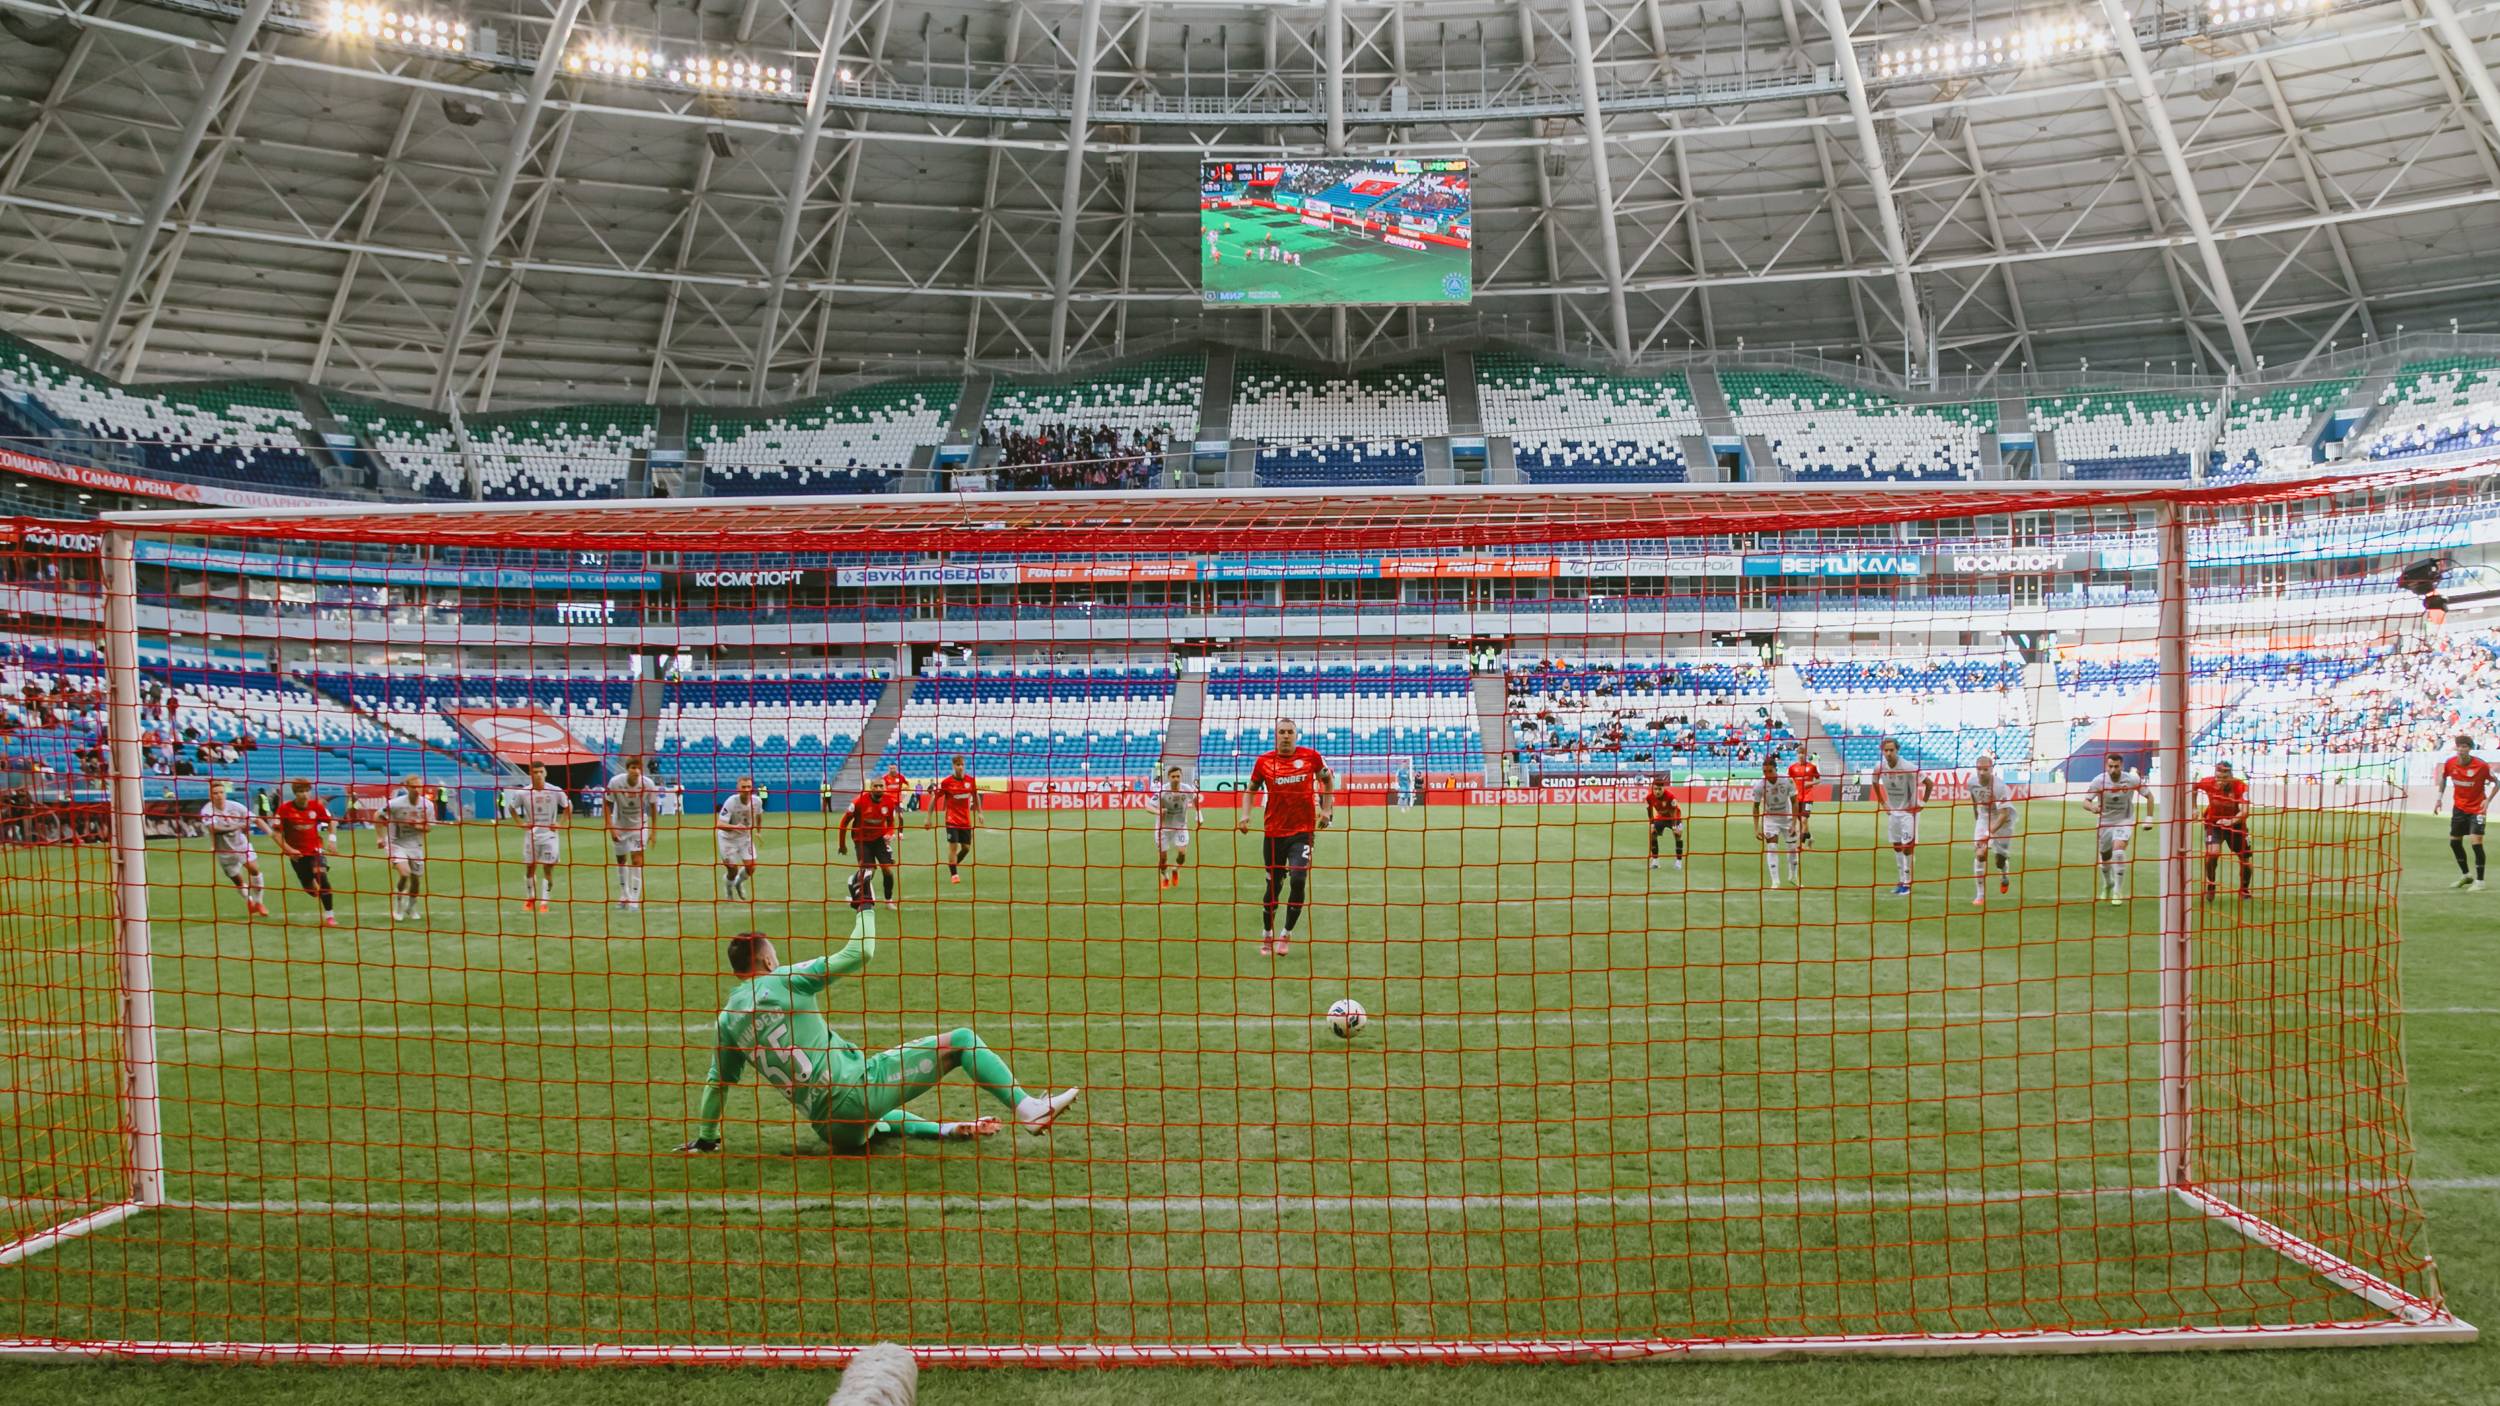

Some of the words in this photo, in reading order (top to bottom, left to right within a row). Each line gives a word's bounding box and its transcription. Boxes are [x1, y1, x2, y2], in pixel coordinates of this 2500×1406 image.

[81, 470, 131, 490] САМАРА
[134, 481, 174, 497] АРЕНА
[1389, 562, 1437, 573] FONBET
[1446, 561, 1495, 573] FONBET
[1504, 560, 1550, 572] FONBET
[1593, 562, 1625, 572] ДСК
[1630, 558, 1734, 572] ТРАНССТРОЙ
[1781, 557, 1918, 573] ВЕРТИКАЛЬ
[1953, 554, 2067, 572] КОСМОПОРТ
[856, 570, 916, 582] ЗВУКИ
[919, 568, 995, 582] ПОБЕДЫ
[1083, 566, 1132, 577] FONBET
[1140, 565, 1189, 576] FONBET
[695, 570, 804, 587] КОСМОПОРТ
[1471, 789, 1546, 804] ПЕРВЫЙ
[1553, 787, 1649, 804] БУКМЕКЕР
[1842, 785, 1860, 793] FON
[1027, 794, 1103, 809] ПЕРВЫЙ
[1842, 793, 1860, 802] BET
